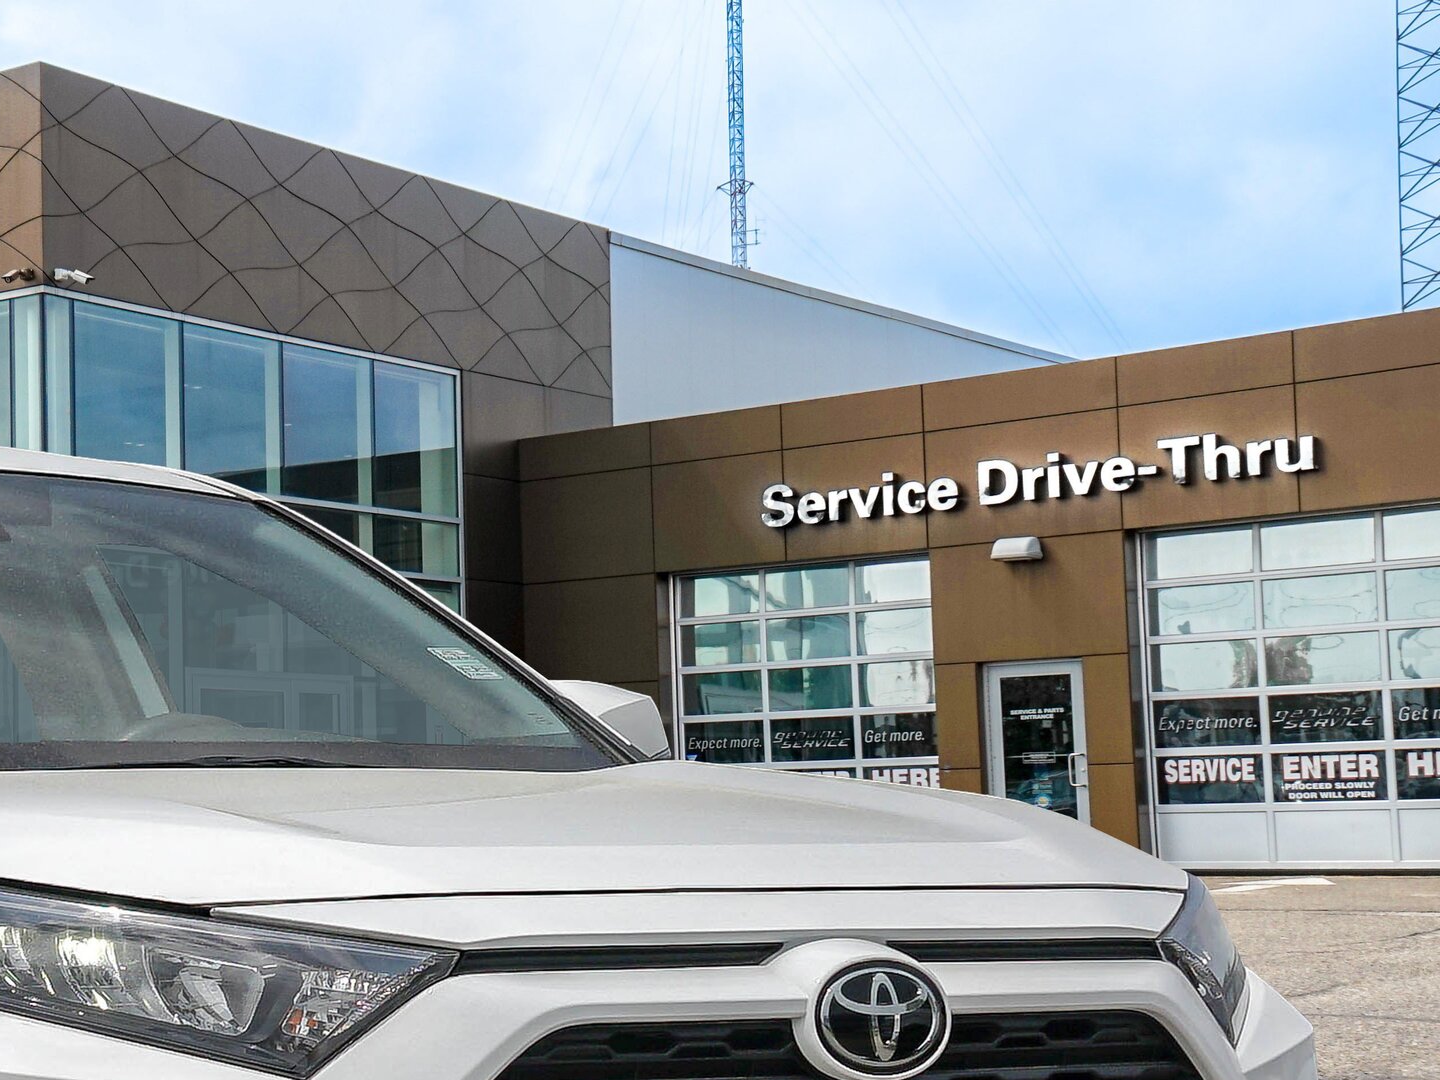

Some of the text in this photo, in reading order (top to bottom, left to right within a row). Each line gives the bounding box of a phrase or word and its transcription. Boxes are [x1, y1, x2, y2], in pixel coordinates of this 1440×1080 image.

[761, 433, 1318, 528] Service Drive-Thru
[1020, 713, 1055, 721] ENTRANCE
[1398, 706, 1429, 722] Get
[1159, 716, 1258, 734] Expect more.
[689, 736, 763, 752] Expect more.
[864, 729, 926, 743] Get more.
[1164, 757, 1256, 783] SERVICE
[1282, 753, 1380, 780] ENTER
[1284, 780, 1376, 790] PROCEED SLOWLY
[1288, 790, 1376, 800] DOOR WILL OPEN
